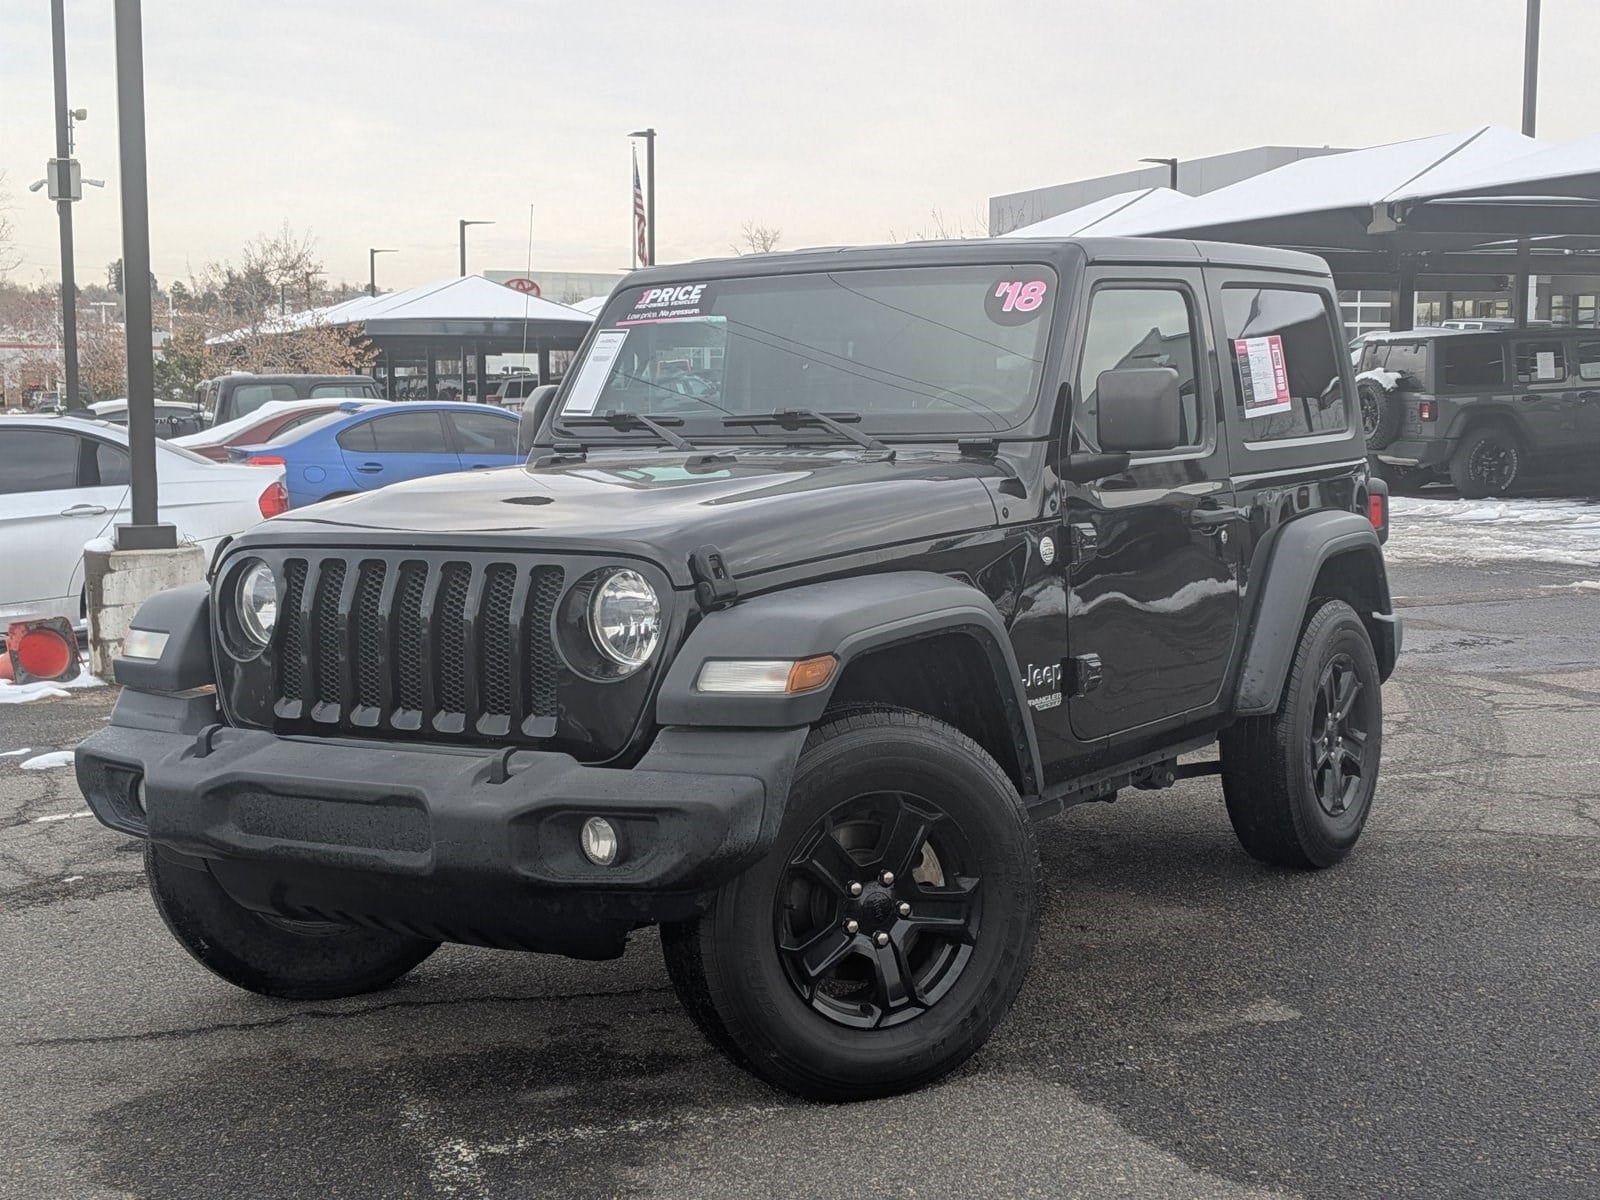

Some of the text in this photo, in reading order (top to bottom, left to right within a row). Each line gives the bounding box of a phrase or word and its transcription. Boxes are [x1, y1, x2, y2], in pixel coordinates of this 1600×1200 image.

[627, 312, 641, 320] Low
[658, 309, 669, 318] No
[1021, 663, 1061, 690] Jeep
